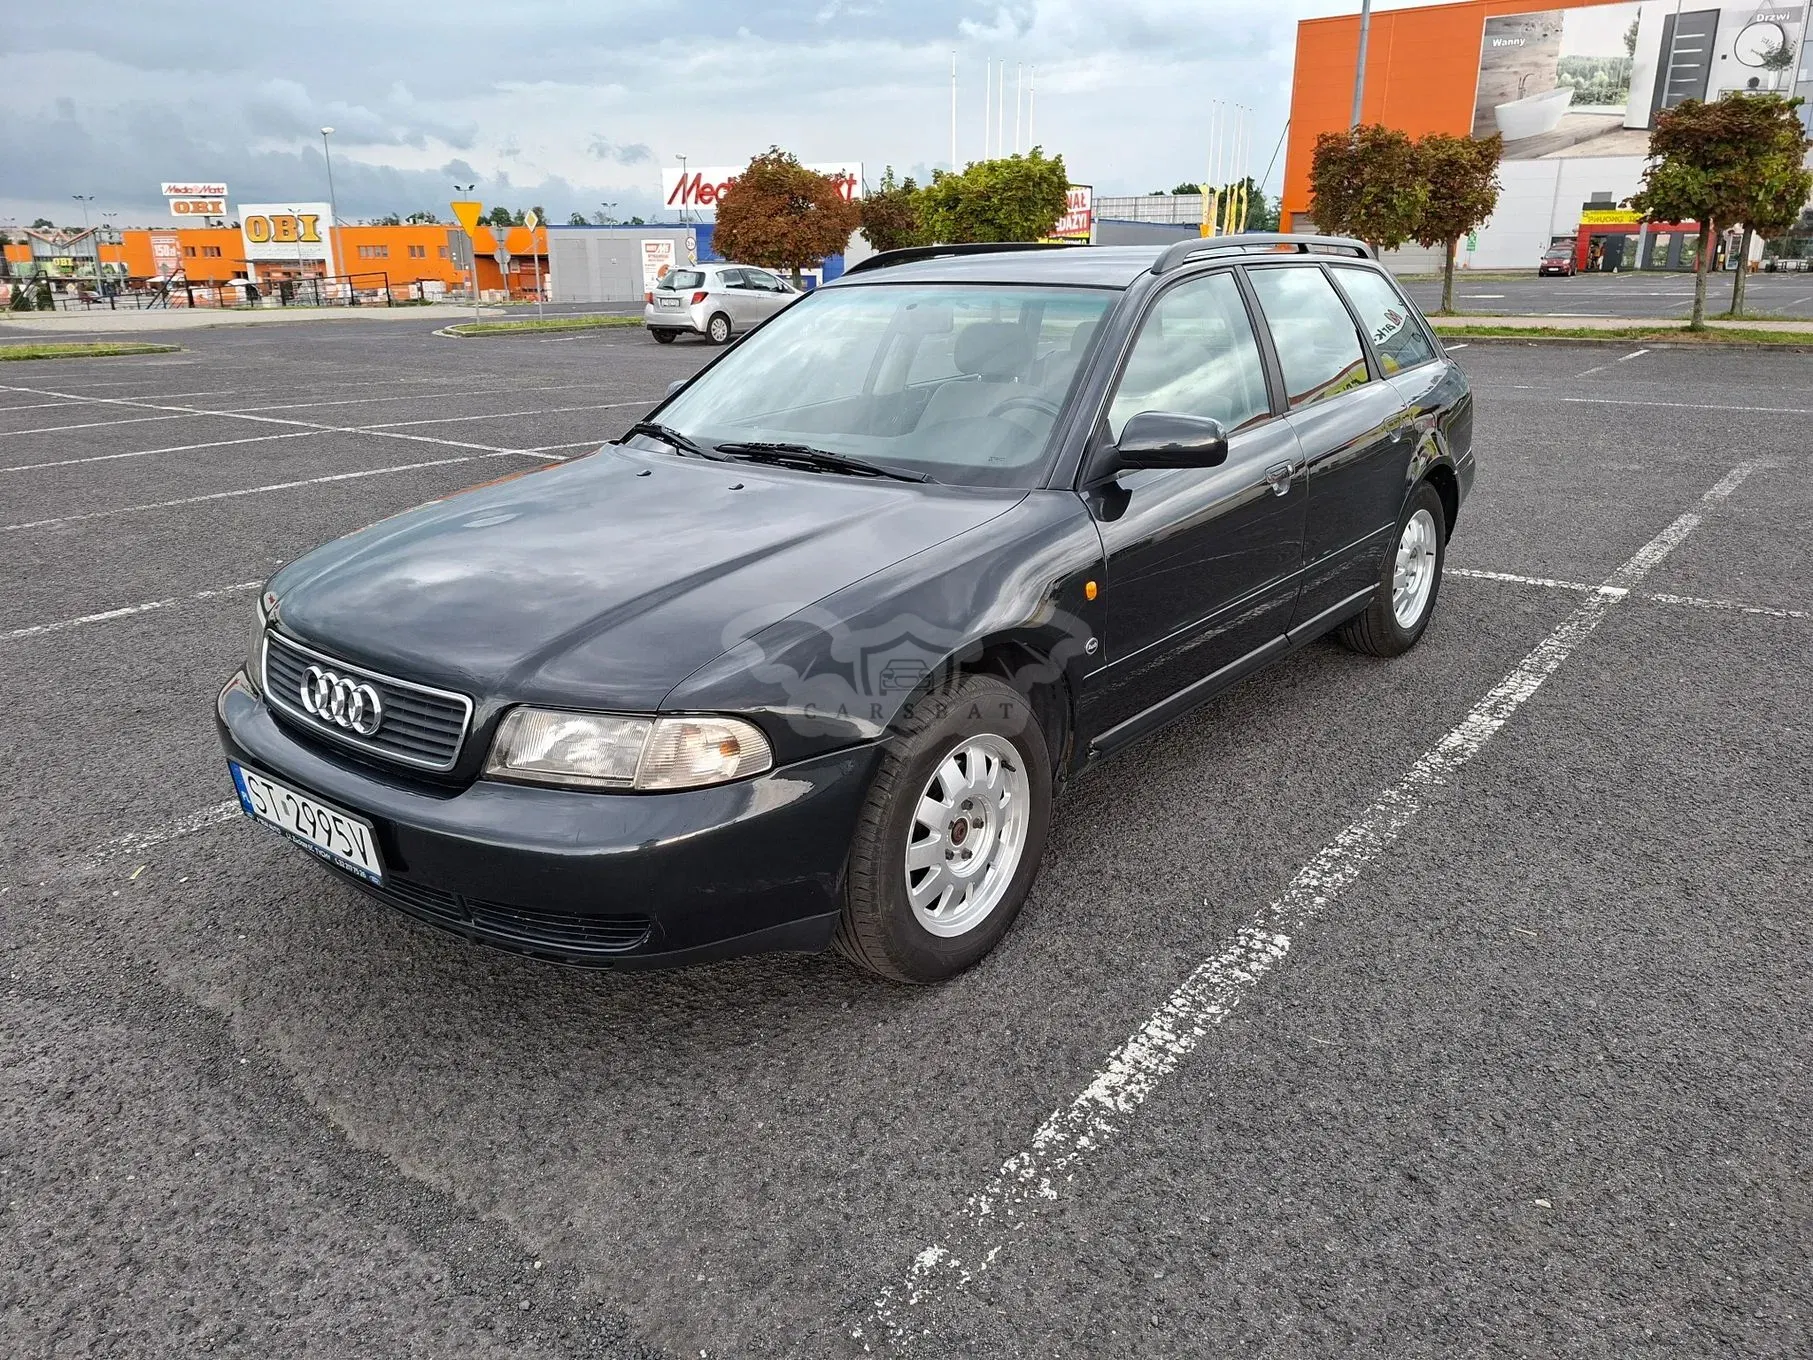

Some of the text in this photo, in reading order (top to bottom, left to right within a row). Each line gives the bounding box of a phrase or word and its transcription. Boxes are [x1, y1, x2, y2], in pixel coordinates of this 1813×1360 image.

[1756, 11, 1791, 22] Drzwi
[1492, 38, 1526, 47] Wanny
[667, 173, 737, 205] Med
[173, 201, 223, 214] OBI
[245, 215, 323, 243] OBI
[53, 258, 73, 266] OBI
[247, 775, 369, 866] ST 2995V
